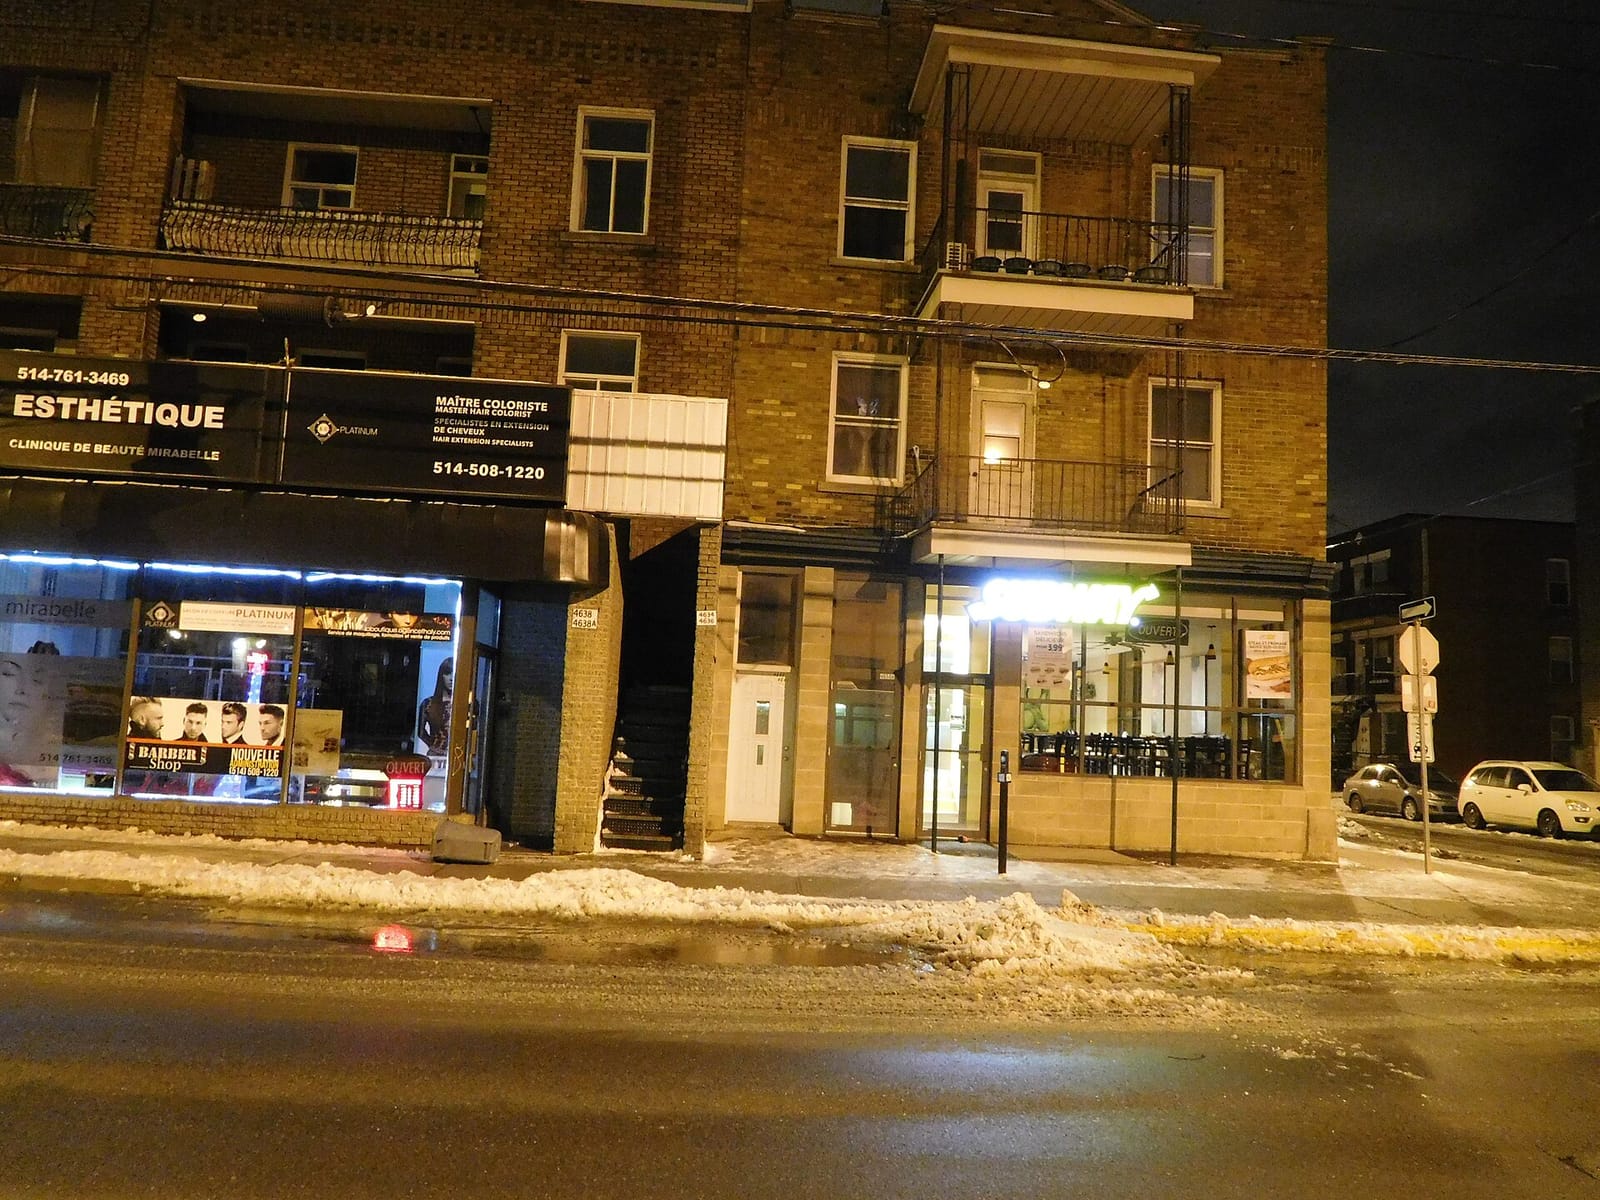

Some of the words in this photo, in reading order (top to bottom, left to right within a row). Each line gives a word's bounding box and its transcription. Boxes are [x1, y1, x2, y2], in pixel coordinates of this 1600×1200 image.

[17, 367, 130, 386] 514-761-3469
[436, 395, 481, 408] MAÎTRE
[483, 399, 548, 412] COLORISTE
[13, 394, 225, 429] ESTHÉTIQUE
[435, 406, 468, 415] MASTER
[469, 408, 490, 416] HAIR
[491, 409, 532, 418] COLORIST
[339, 425, 378, 436] PLATINUM
[433, 426, 446, 434] DE
[446, 427, 486, 436] CHEVEUX
[503, 422, 550, 431] EXTENSION
[432, 435, 450, 443] HAIR
[451, 437, 491, 445] EXTENSION
[491, 439, 534, 448] SPECIALISTS
[9, 438, 71, 452] CLINIQUE
[73, 442, 90, 453] DE
[93, 444, 144, 456] BEAUTÉ
[147, 447, 220, 461] MIRABELLE
[432, 461, 546, 480] 514-508-1220
[6, 599, 96, 618] mirabelle
[967, 581, 1160, 625] SWAY
[235, 609, 294, 620] PLATINUM
[572, 608, 593, 618] 4638
[572, 619, 597, 628] 4638A
[1138, 624, 1177, 637] OUVERT
[40, 753, 59, 762] 514
[138, 747, 197, 761] BARBER
[231, 748, 280, 761] NOUVELLE
[149, 759, 182, 772] Shop
[386, 761, 425, 775] OUVERT
